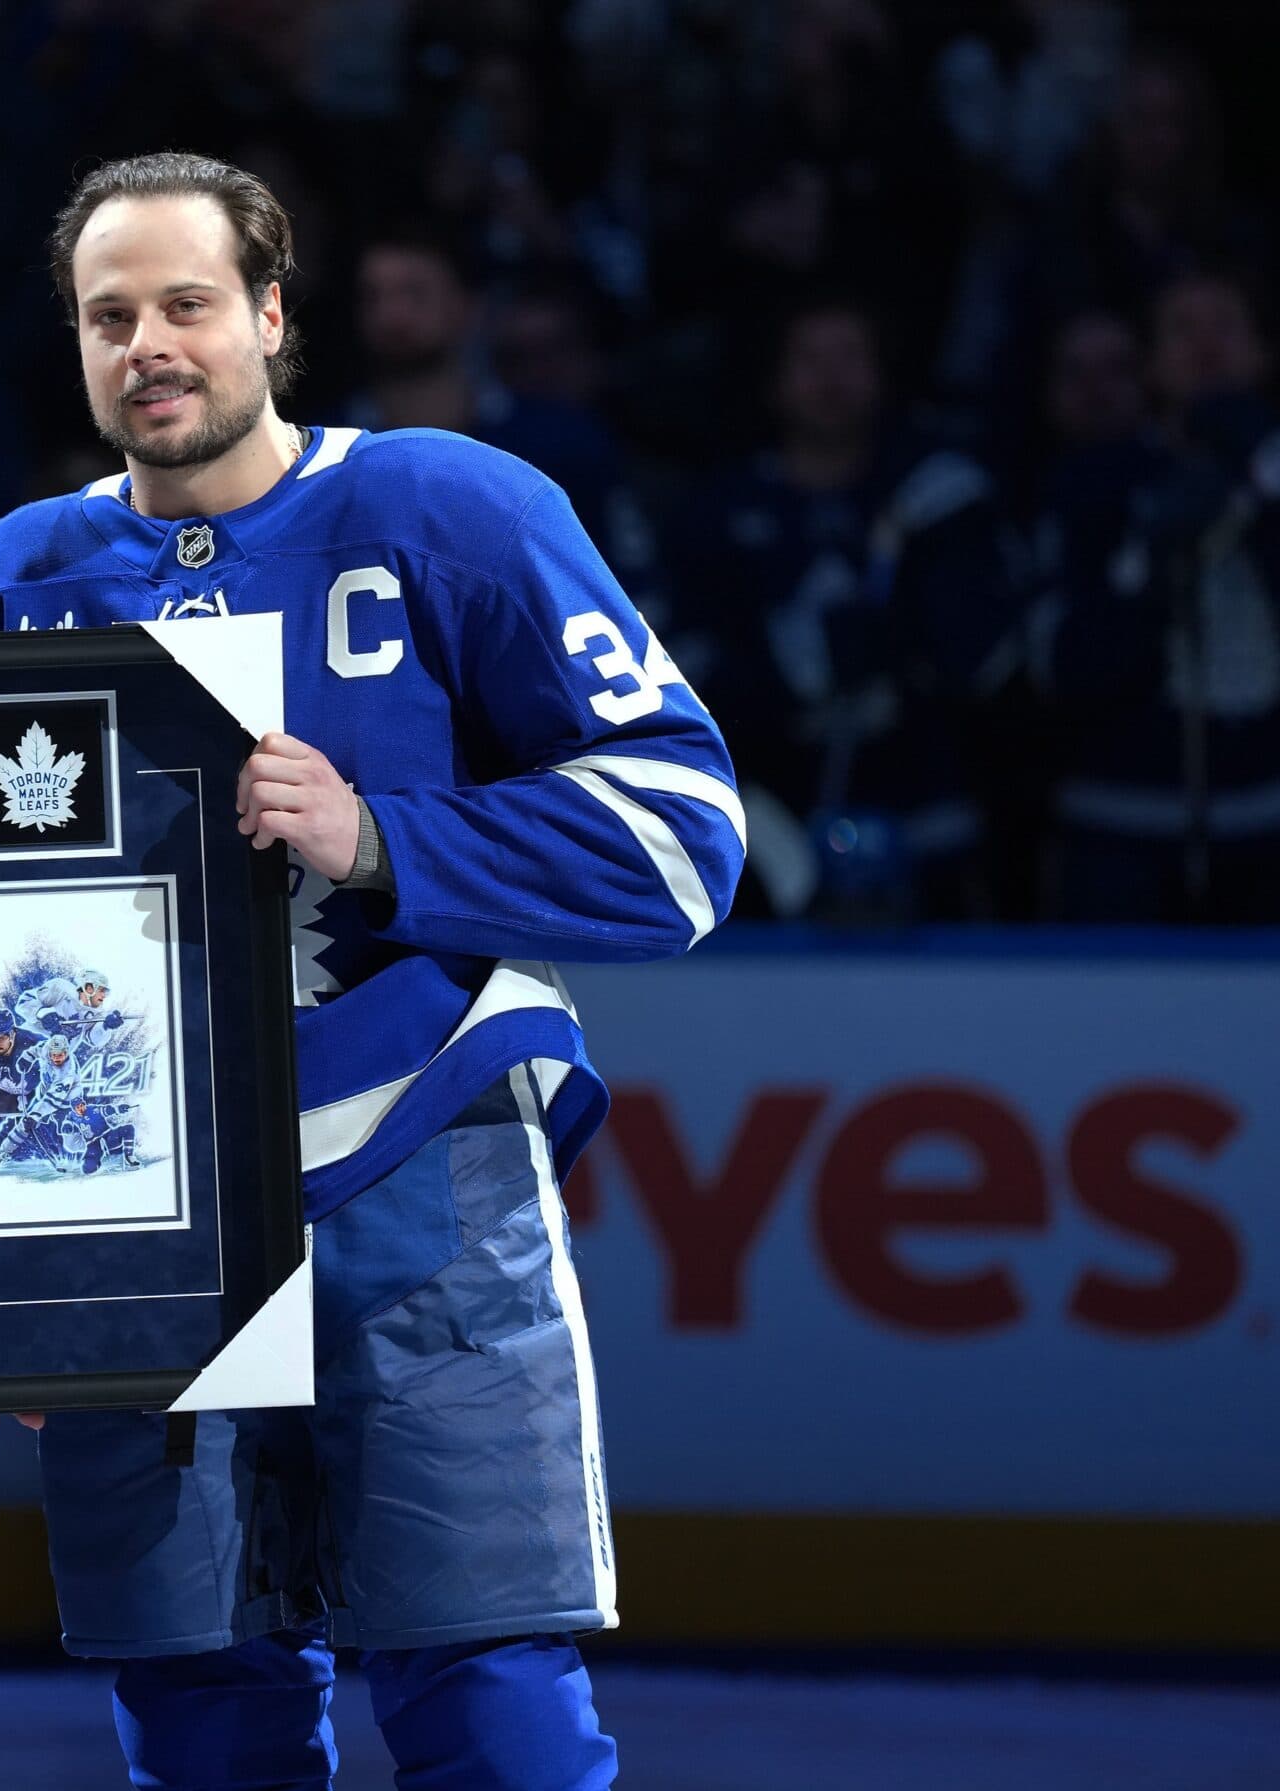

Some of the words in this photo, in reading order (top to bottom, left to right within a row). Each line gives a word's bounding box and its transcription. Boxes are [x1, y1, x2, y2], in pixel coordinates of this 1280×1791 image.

[185, 536, 207, 560] NHL
[327, 566, 403, 678] C
[8, 772, 68, 790] TORONTO
[19, 788, 58, 798] MAPLE
[20, 800, 59, 811] LEAFS
[81, 1049, 154, 1098] 421
[54, 1082, 70, 1093] 34
